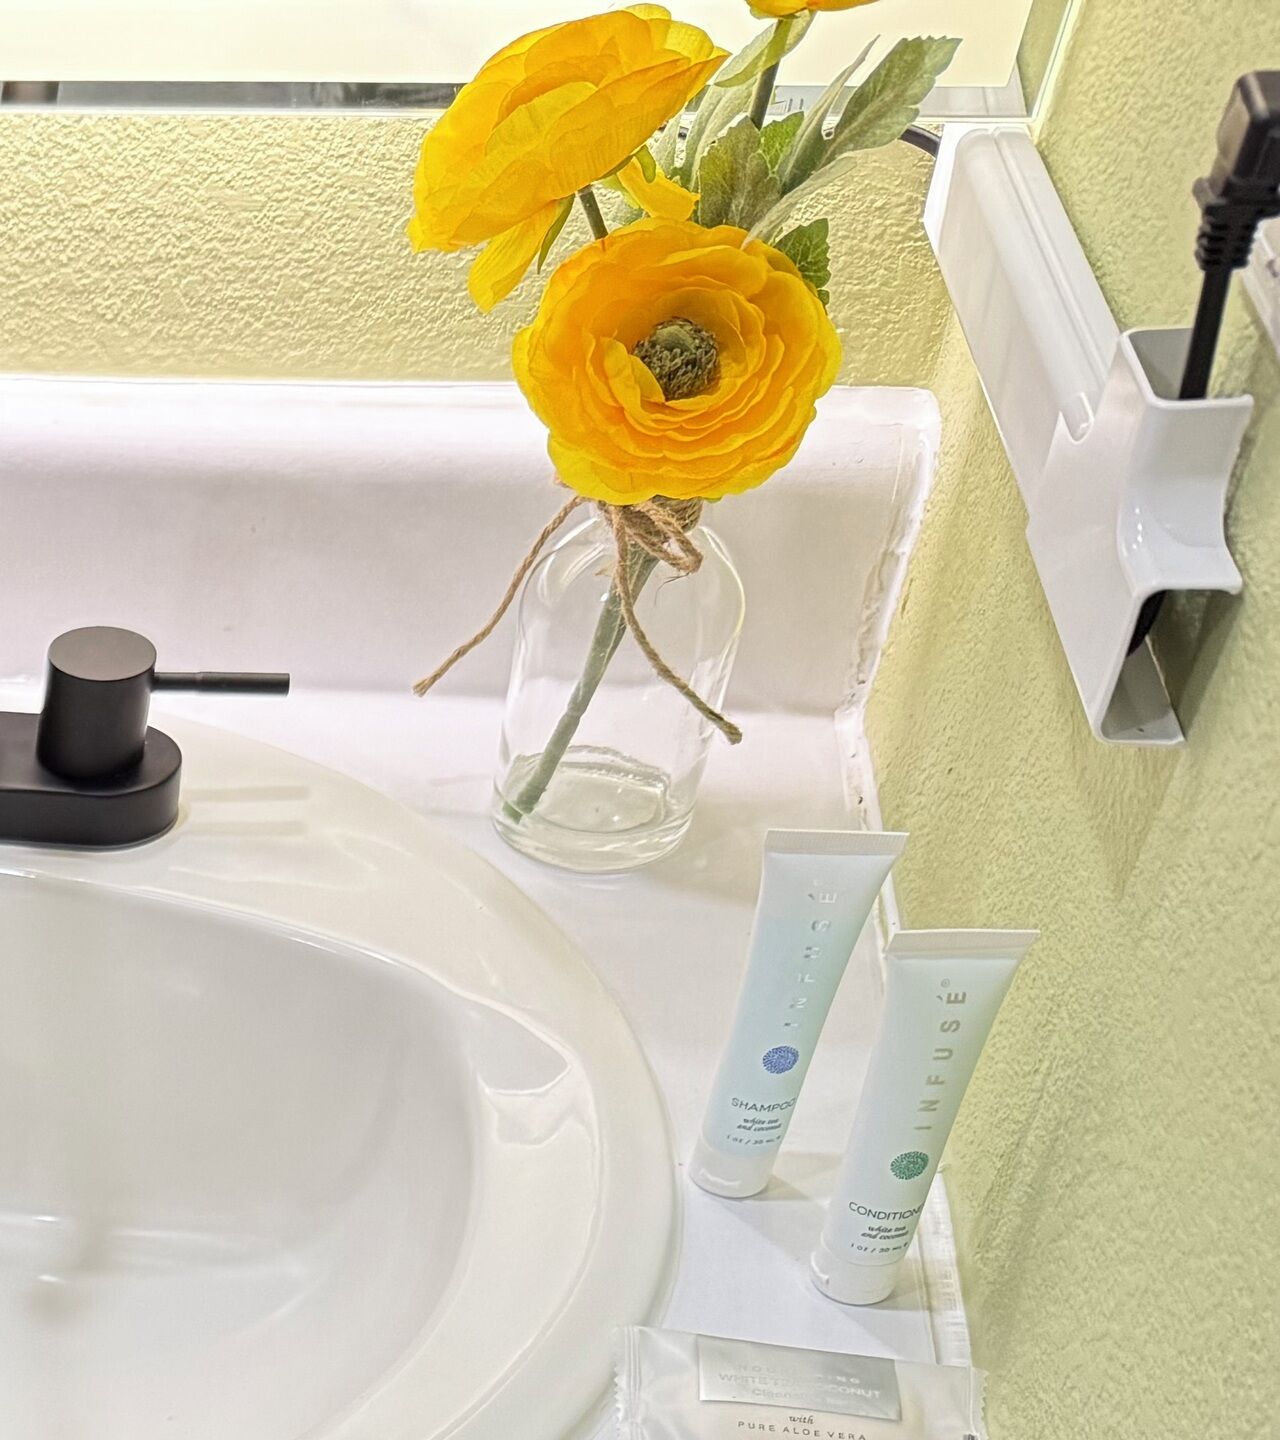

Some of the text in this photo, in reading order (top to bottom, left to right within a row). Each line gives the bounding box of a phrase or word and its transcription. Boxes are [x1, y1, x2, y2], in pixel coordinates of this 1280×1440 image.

[731, 1097, 797, 1112] SHAMPOO
[789, 1414, 815, 1425] with
[738, 1420, 776, 1433] PURE
[783, 1426, 820, 1438] ALOE
